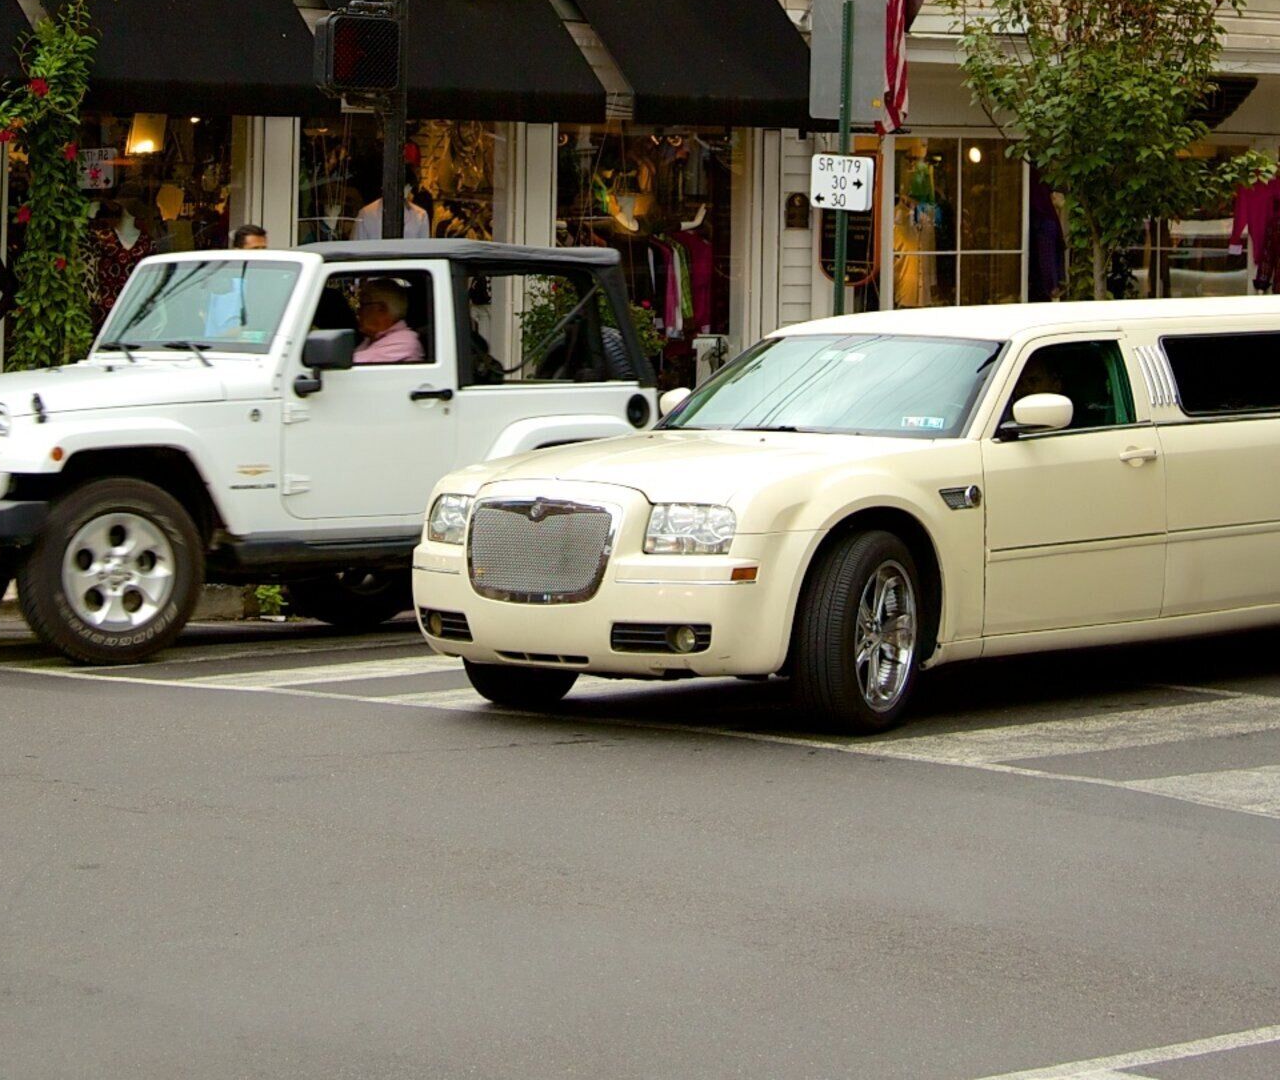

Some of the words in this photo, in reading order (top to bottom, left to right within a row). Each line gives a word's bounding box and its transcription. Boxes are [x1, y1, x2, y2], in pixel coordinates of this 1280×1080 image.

[818, 157, 834, 172] SR
[841, 159, 861, 174] 179
[831, 175, 848, 191] 30
[831, 193, 846, 207] 30
